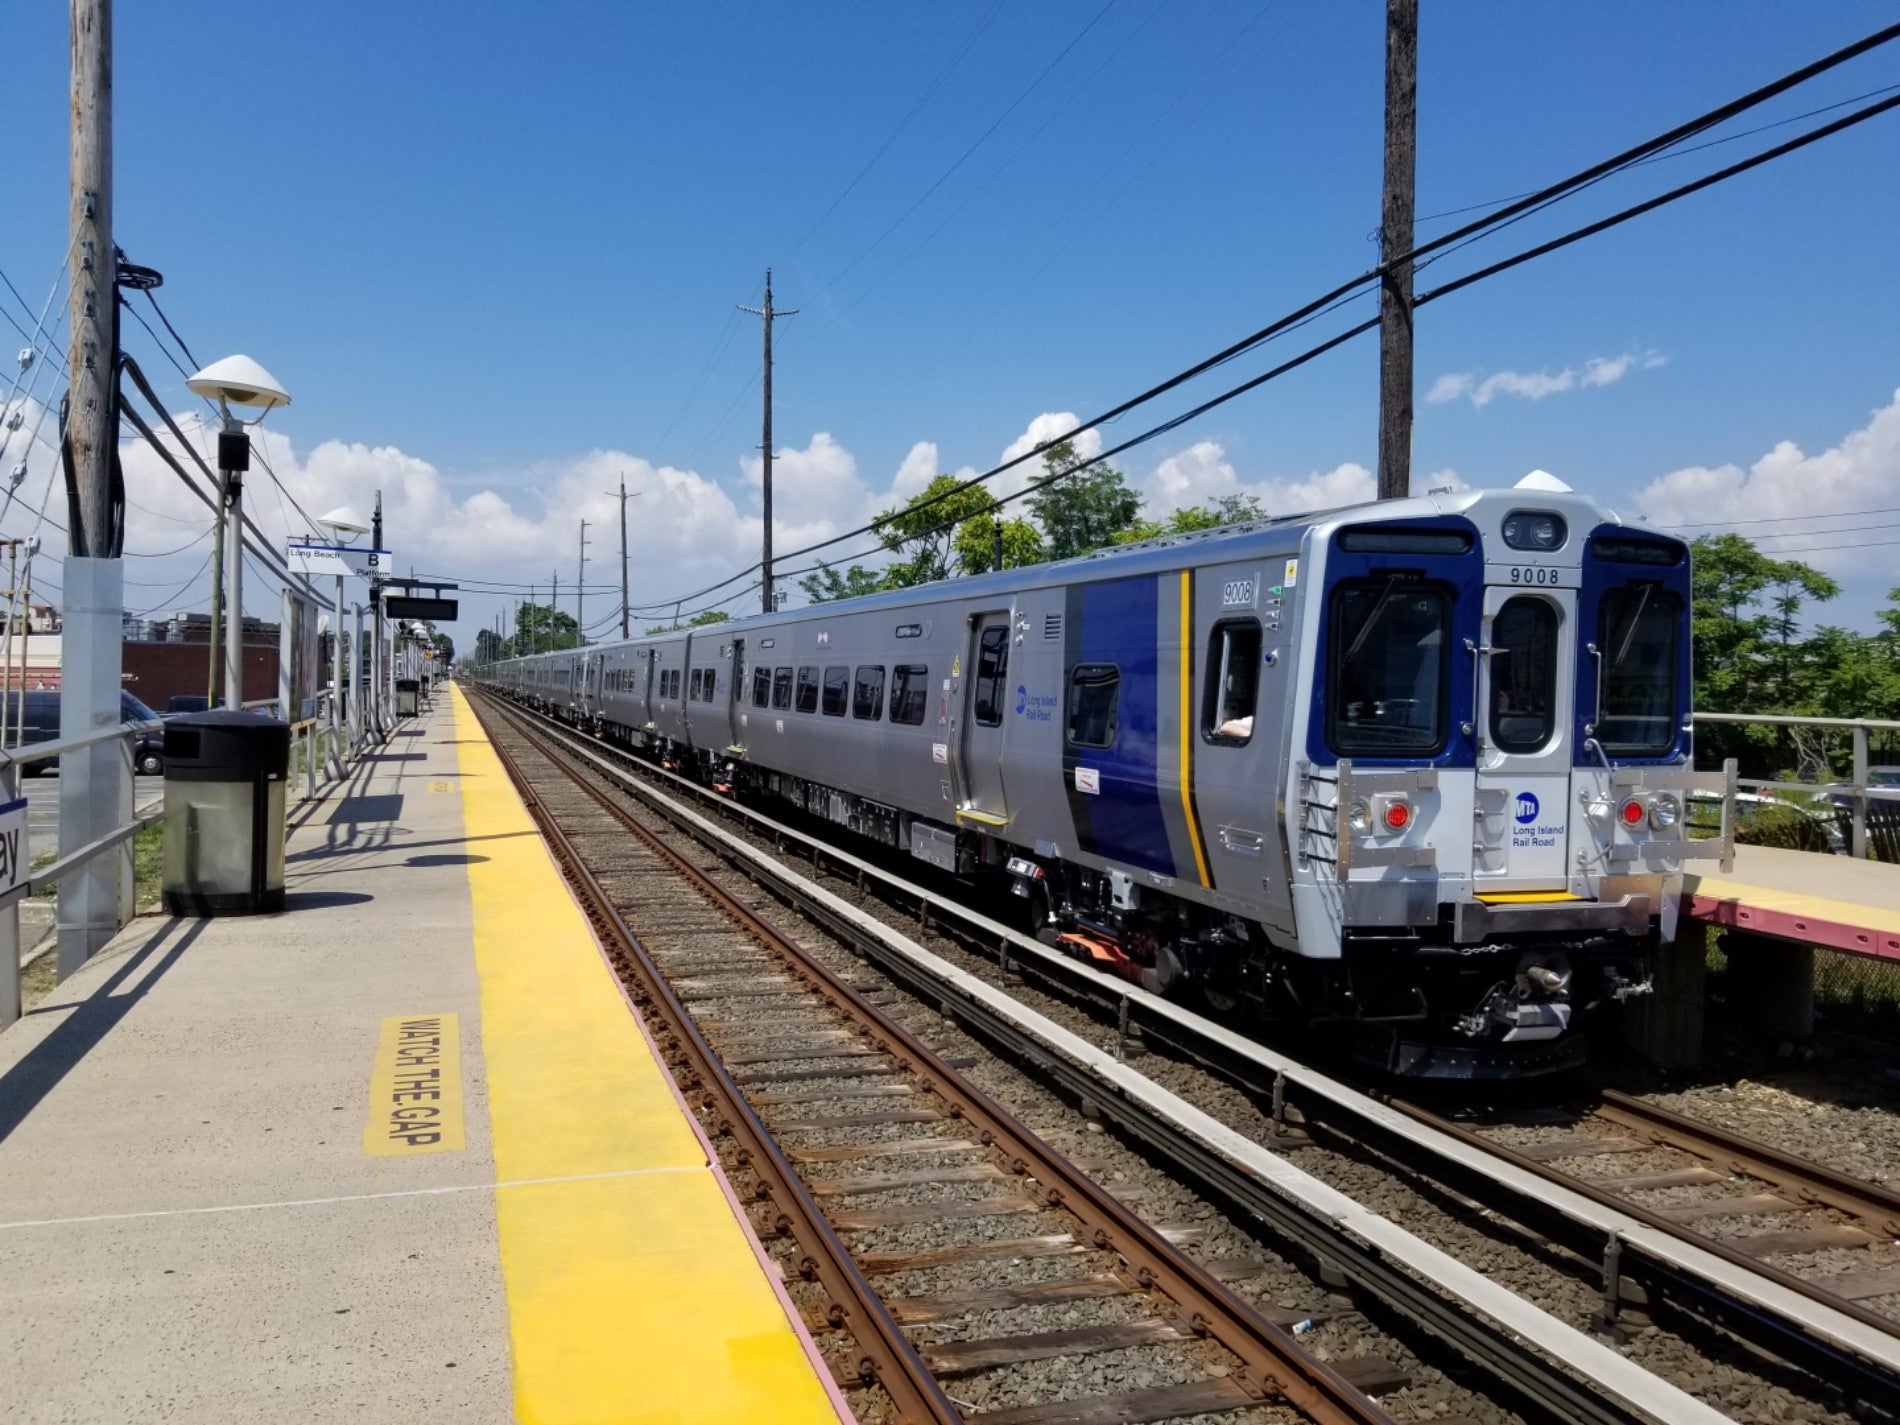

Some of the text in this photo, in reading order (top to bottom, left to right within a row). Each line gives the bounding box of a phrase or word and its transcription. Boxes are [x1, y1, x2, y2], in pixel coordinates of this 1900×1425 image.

[290, 549, 340, 559] Long Beach
[368, 553, 380, 567] B
[356, 568, 390, 577] Platform
[1511, 568, 1558, 584] 9008
[1225, 582, 1252, 603] 9008
[1515, 797, 1537, 820] MTA
[1513, 826, 1564, 837] Long Island
[1513, 838, 1555, 847] Rail Road
[397, 1018, 441, 1067] WATCH
[389, 1107, 441, 1146] GAP
